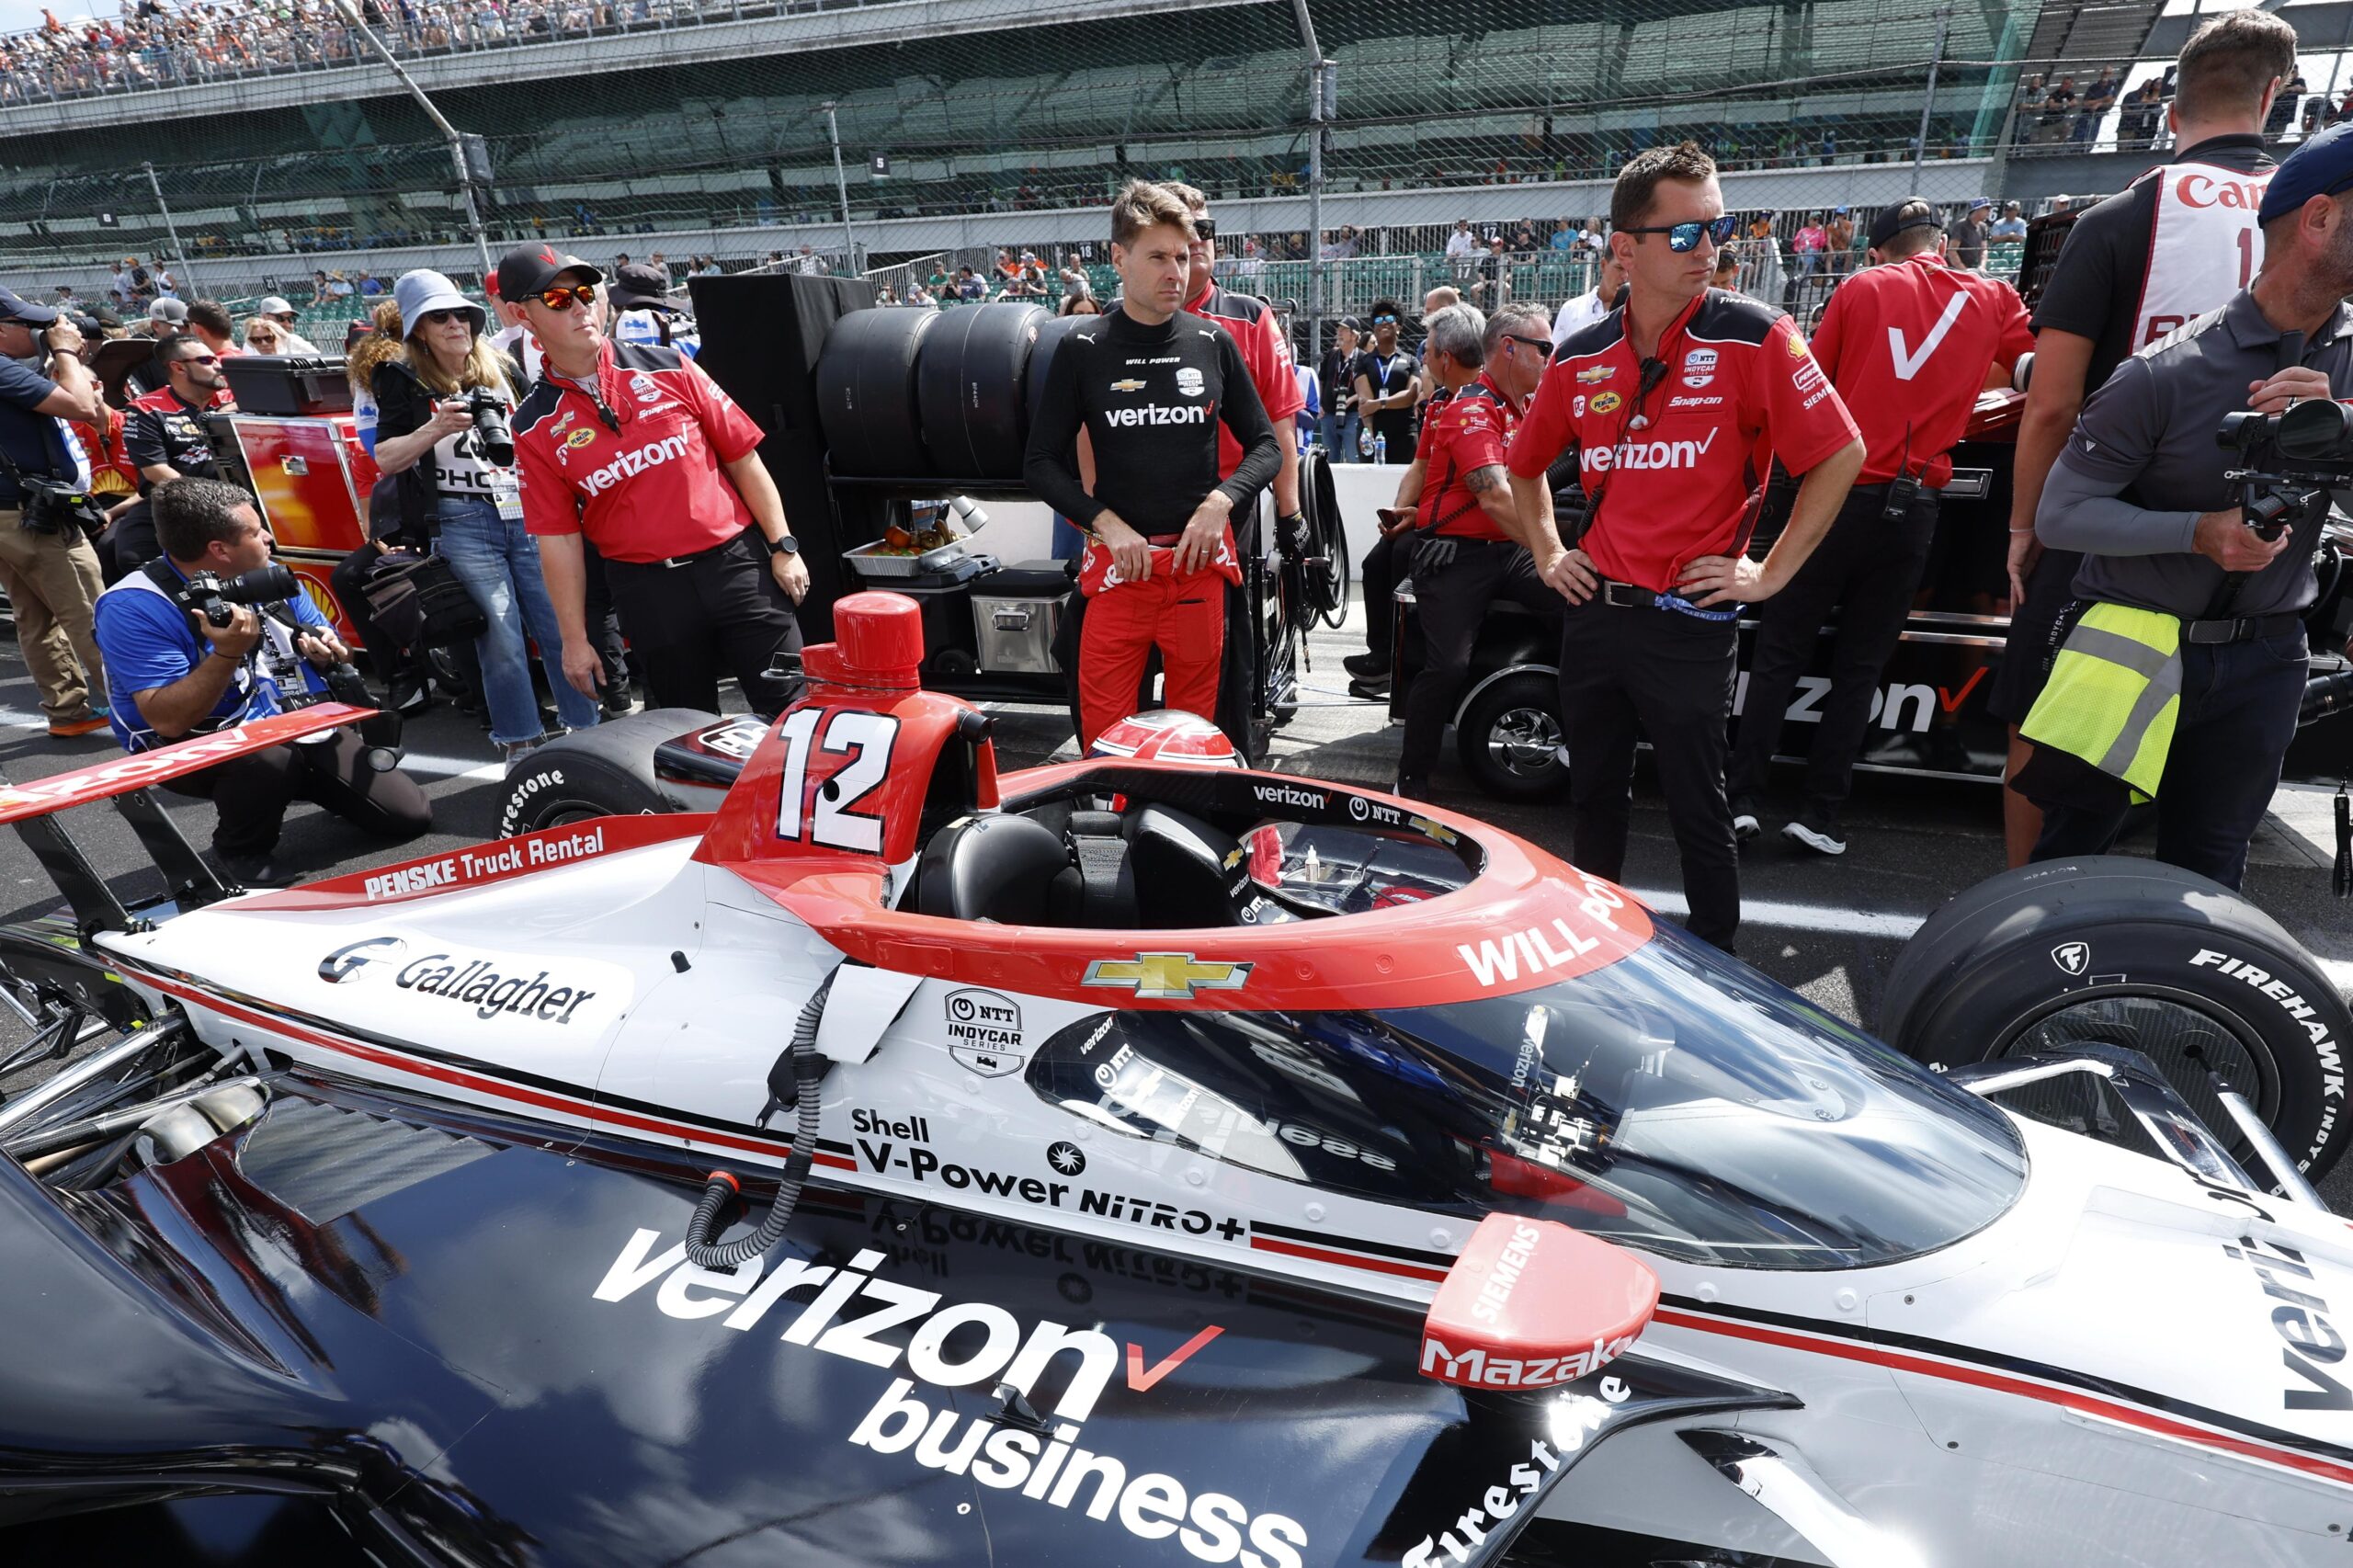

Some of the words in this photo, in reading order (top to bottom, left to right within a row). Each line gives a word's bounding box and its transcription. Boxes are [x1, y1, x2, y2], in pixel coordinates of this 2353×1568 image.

[876, 157, 884, 168] 5
[2177, 174, 2268, 210] Can
[1079, 244, 1092, 258] 18
[1483, 226, 1496, 240] 17
[1125, 358, 1146, 366] WILL
[1684, 365, 1715, 373] INDYCAR
[638, 402, 678, 420] Snap-on
[1105, 403, 1205, 427] verizon
[1669, 396, 1723, 407] Snap-on
[577, 436, 688, 497] verizon
[1579, 436, 1696, 472] verizon
[436, 467, 494, 489] PHO
[0, 739, 244, 802] izon
[778, 706, 901, 856] 12
[499, 769, 564, 839] irestone
[1253, 785, 1324, 810] verizon
[1371, 805, 1401, 825] NTT
[364, 858, 458, 902] PENSKE
[460, 844, 524, 879] Truck
[528, 825, 605, 866] Rental
[1230, 873, 1250, 898] verizon
[1457, 917, 1601, 987] WILL
[395, 954, 597, 1026] Gallagher
[979, 1005, 1015, 1022] NTT
[948, 1023, 1022, 1046] INDYCAR
[963, 1039, 1006, 1051] SERIES
[1080, 1016, 1114, 1055] verizon
[1109, 1042, 1134, 1072] NTT
[1511, 1038, 1536, 1089] verizon
[2188, 948, 2345, 1100] FIREHAWK
[2308, 1106, 2337, 1160] INDY
[851, 1108, 930, 1144] Shell
[857, 1138, 1070, 1208] V-Power
[1472, 1222, 1540, 1324] SIEMENS
[592, 1229, 1119, 1424] verizon
[1421, 1337, 1624, 1386] Mazak
[847, 1378, 1309, 1568] business
[1401, 1375, 1631, 1568] Firestone
